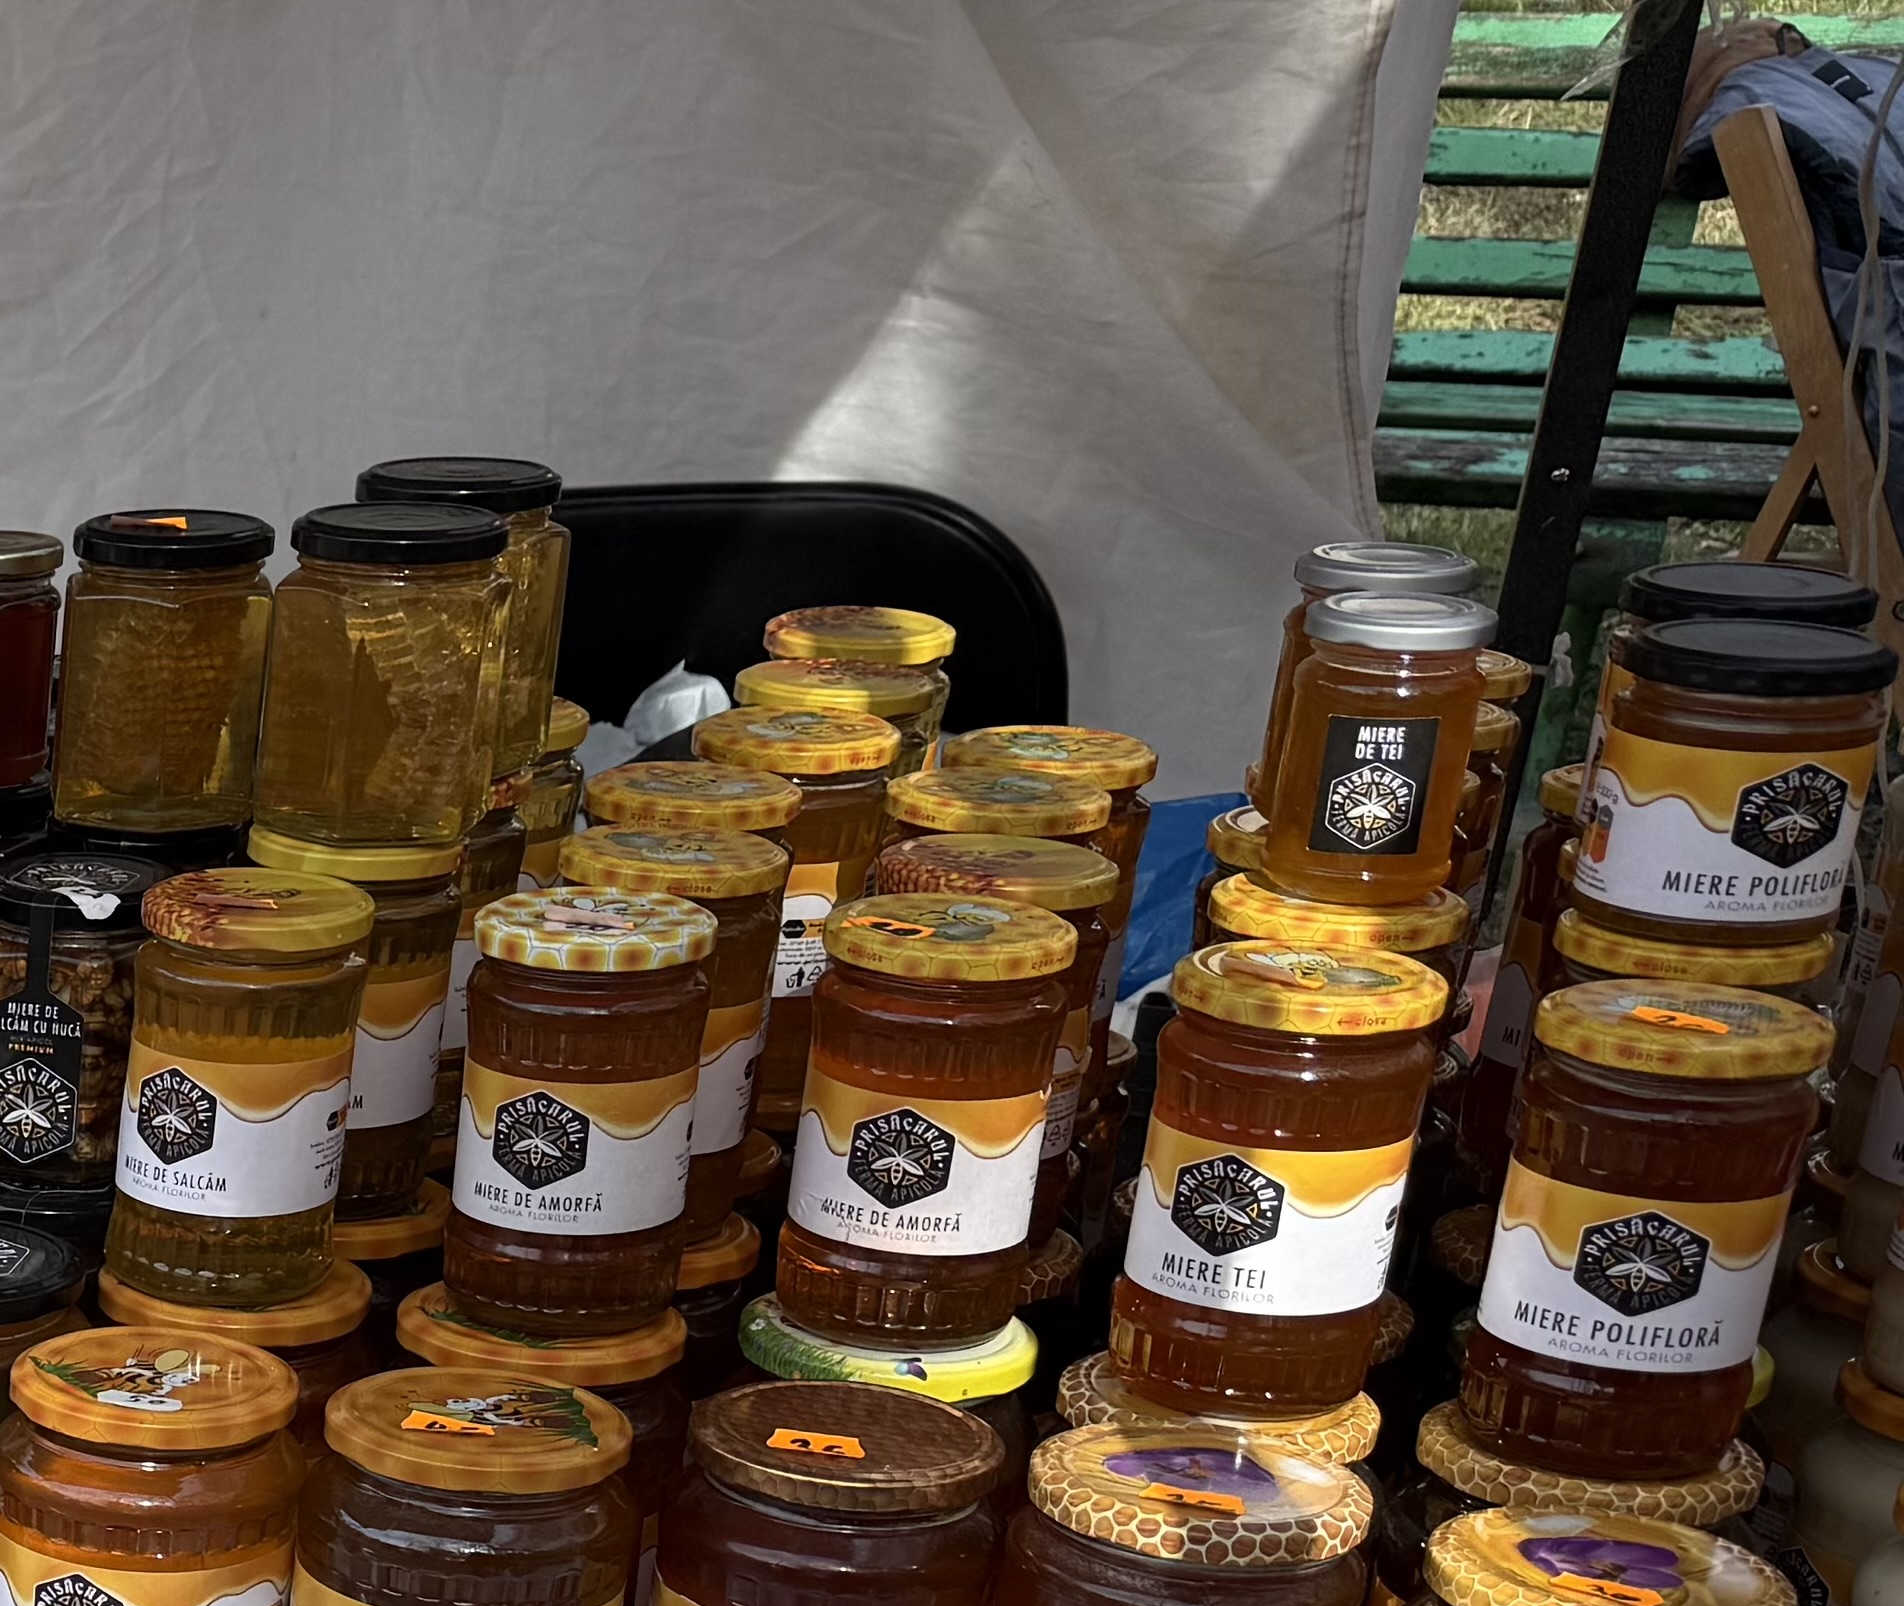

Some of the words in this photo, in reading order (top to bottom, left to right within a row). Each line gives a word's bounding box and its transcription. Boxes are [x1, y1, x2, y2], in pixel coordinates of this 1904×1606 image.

[1358, 726, 1406, 742] MIERE
[1355, 743, 1374, 760] DE
[1381, 744, 1403, 760] TEI
[1332, 770, 1410, 805] PRISACARUL
[1743, 771, 1841, 814] PRISACARUL
[1662, 870, 1739, 896] MIERE
[8, 1001, 40, 1018] MIERE
[45, 1006, 59, 1019] DE
[33, 1021, 47, 1034] CU
[52, 1021, 82, 1038] NUCĂ
[1584, 1218, 1702, 1266] PRISACARUL
[1162, 1252, 1223, 1284] MIERE
[1233, 1267, 1266, 1289] TEI
[1514, 1300, 1581, 1336] MIERE
[1591, 1320, 1724, 1348] POLIFLORĂ
